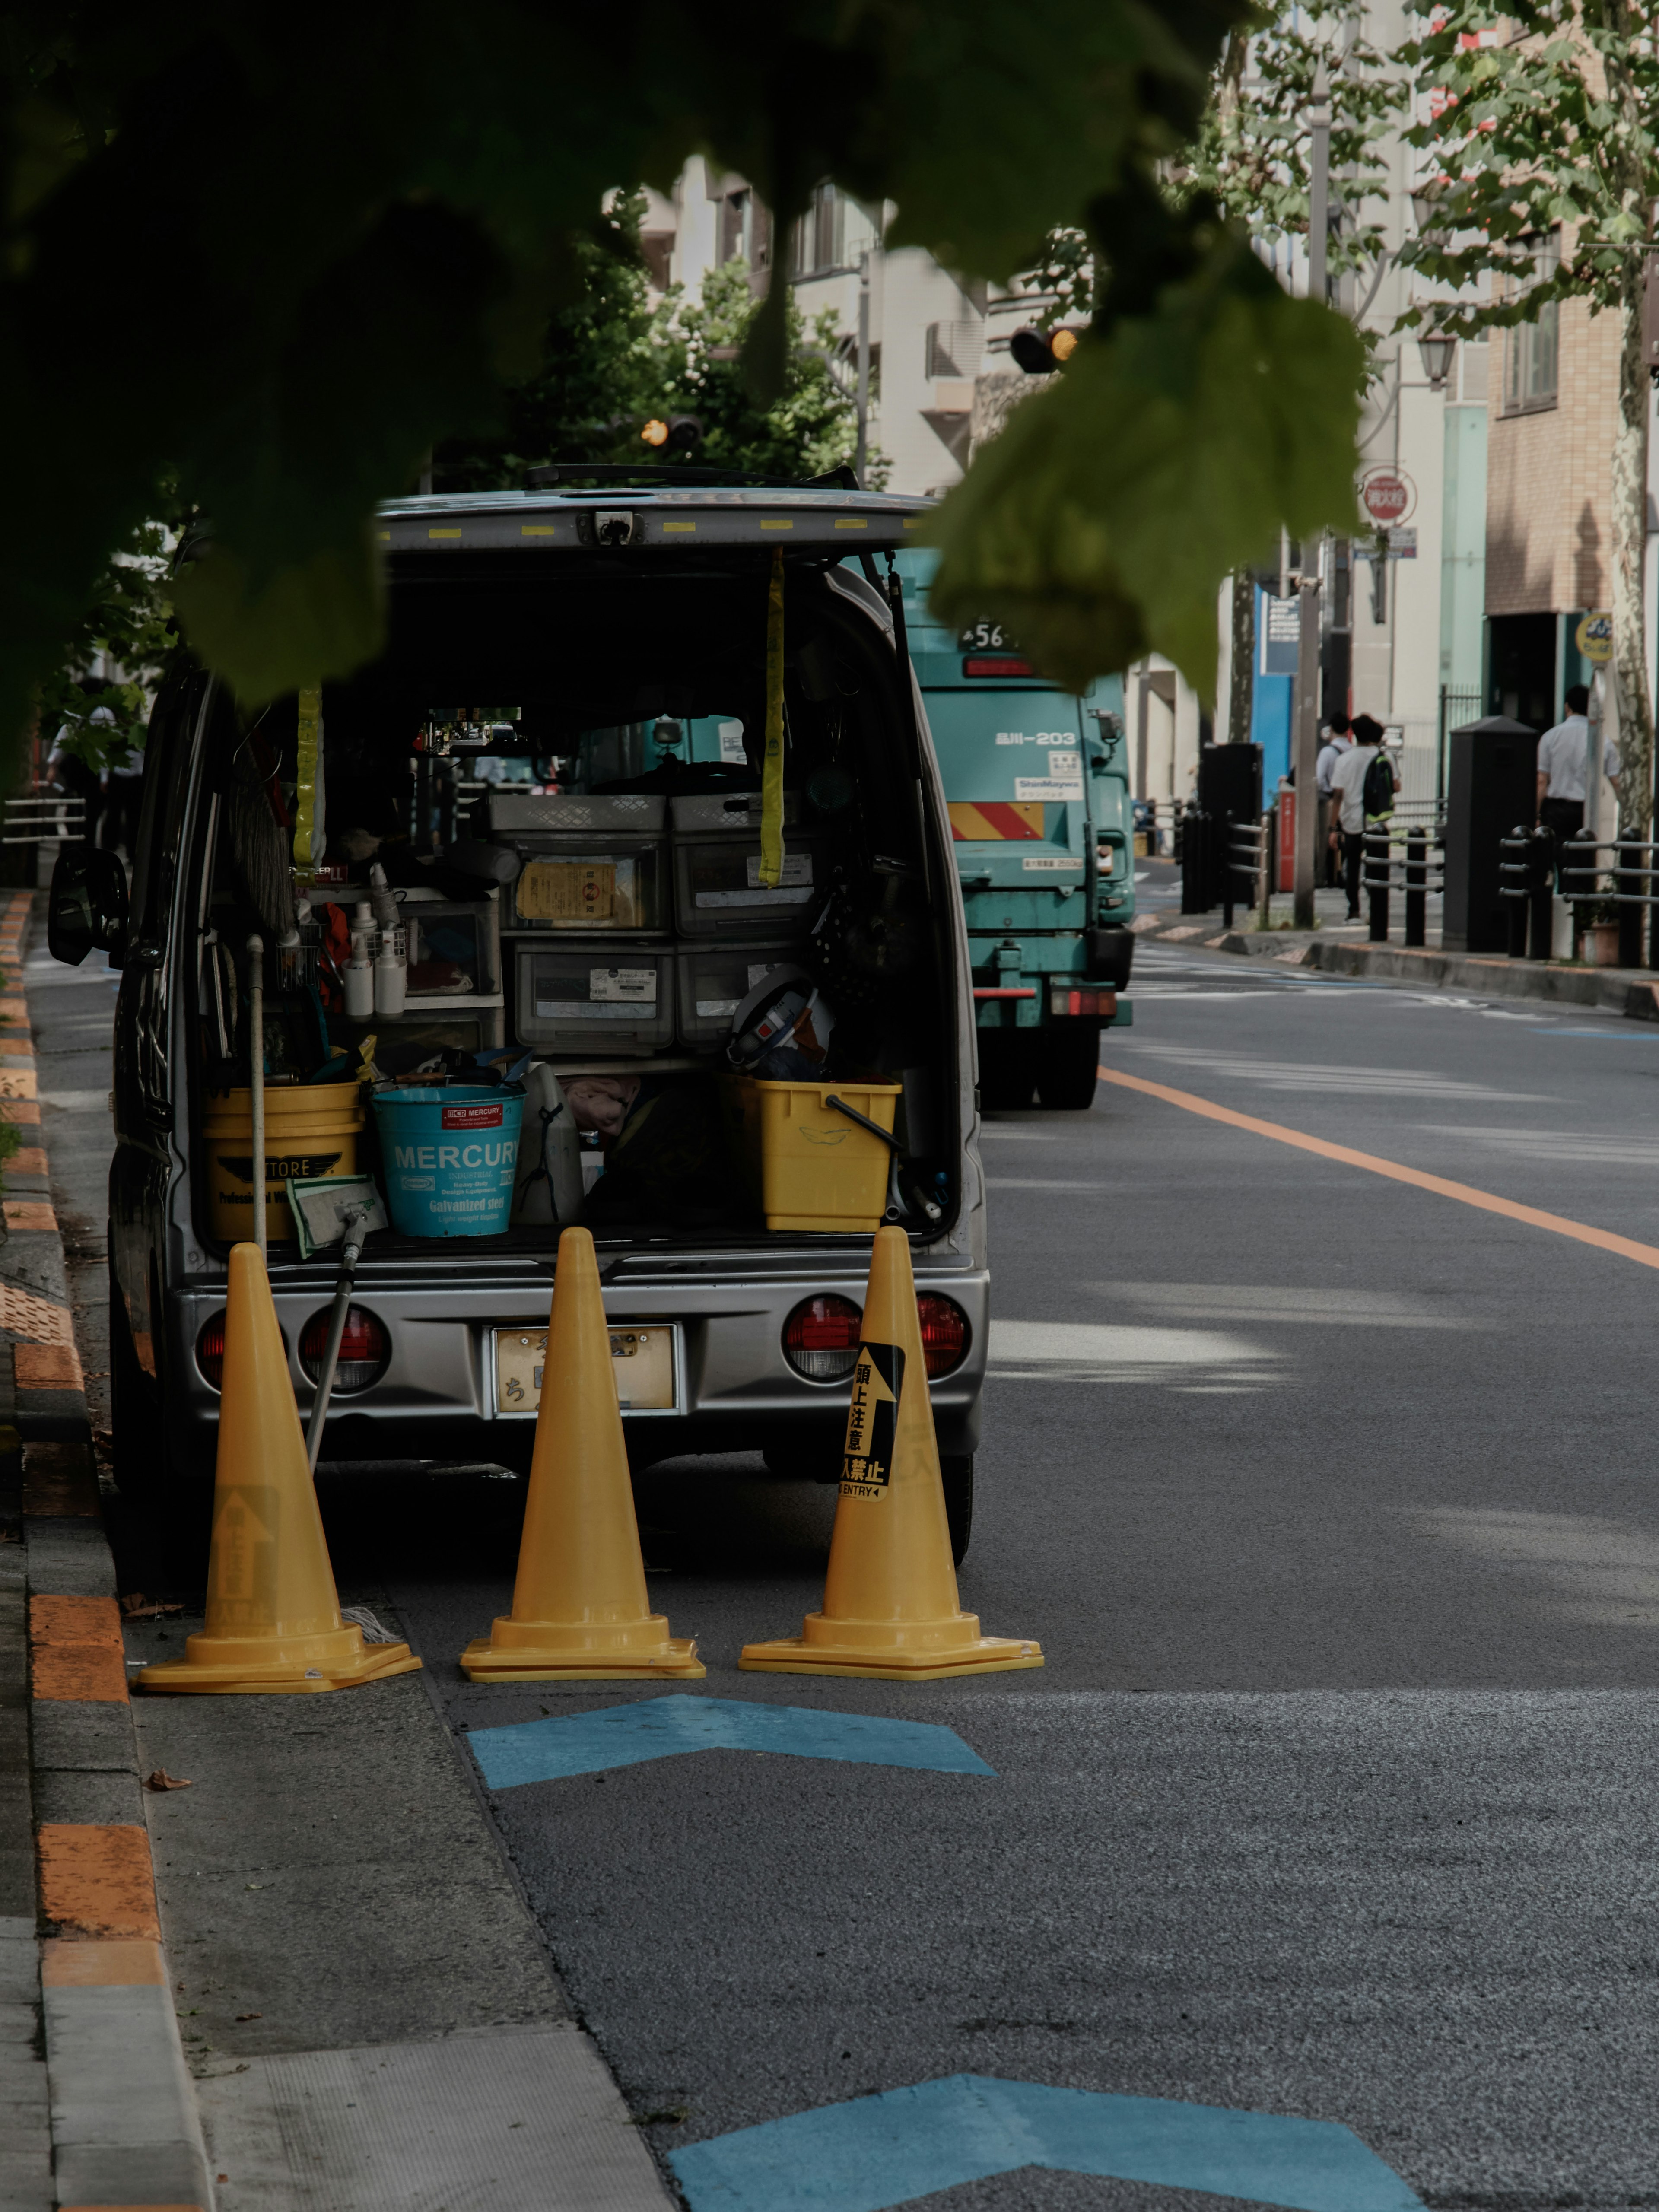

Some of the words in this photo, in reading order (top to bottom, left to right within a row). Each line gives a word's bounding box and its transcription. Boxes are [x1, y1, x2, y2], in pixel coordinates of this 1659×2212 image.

[1368, 488, 1403, 508] 消火栓
[1020, 780, 1079, 788] ShinMaywa
[469, 1107, 500, 1116] MERCURY
[449, 1171, 493, 1179] INDUSTRIAL
[430, 1198, 486, 1212] Galvanized
[488, 1196, 505, 1210] steel
[848, 1364, 871, 1451] 頭上注意
[840, 1457, 884, 1483] 入禁止
[844, 1484, 873, 1497] ENTRY
